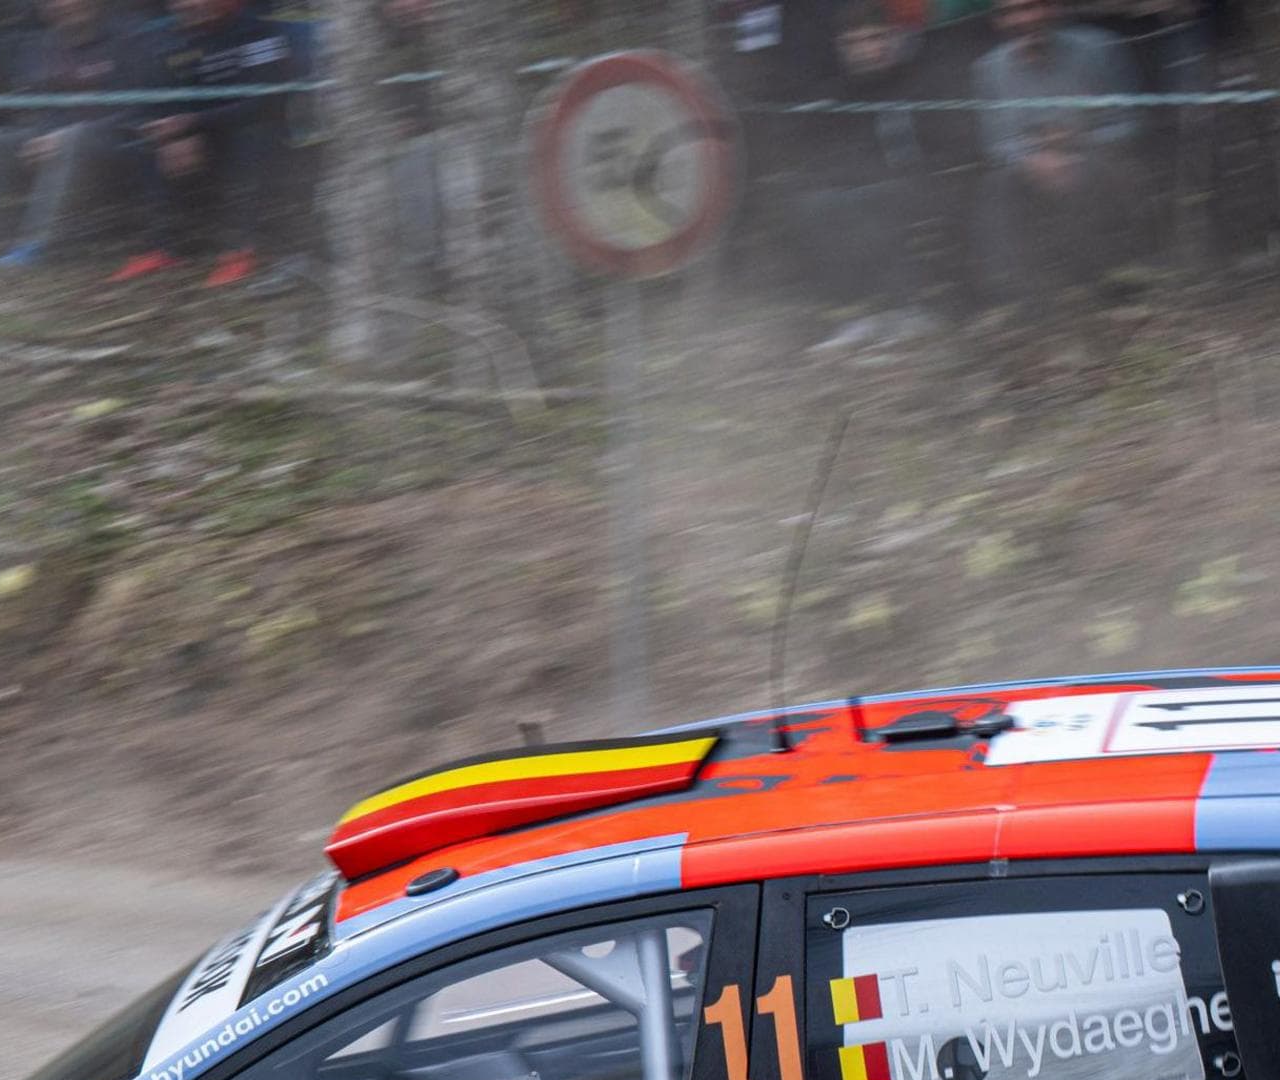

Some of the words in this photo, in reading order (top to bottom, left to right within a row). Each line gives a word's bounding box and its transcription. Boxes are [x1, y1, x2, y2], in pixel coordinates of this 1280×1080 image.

[879, 966, 929, 1017] T.
[947, 927, 1182, 1009] Neuville
[966, 990, 1233, 1079] Wydaeghe
